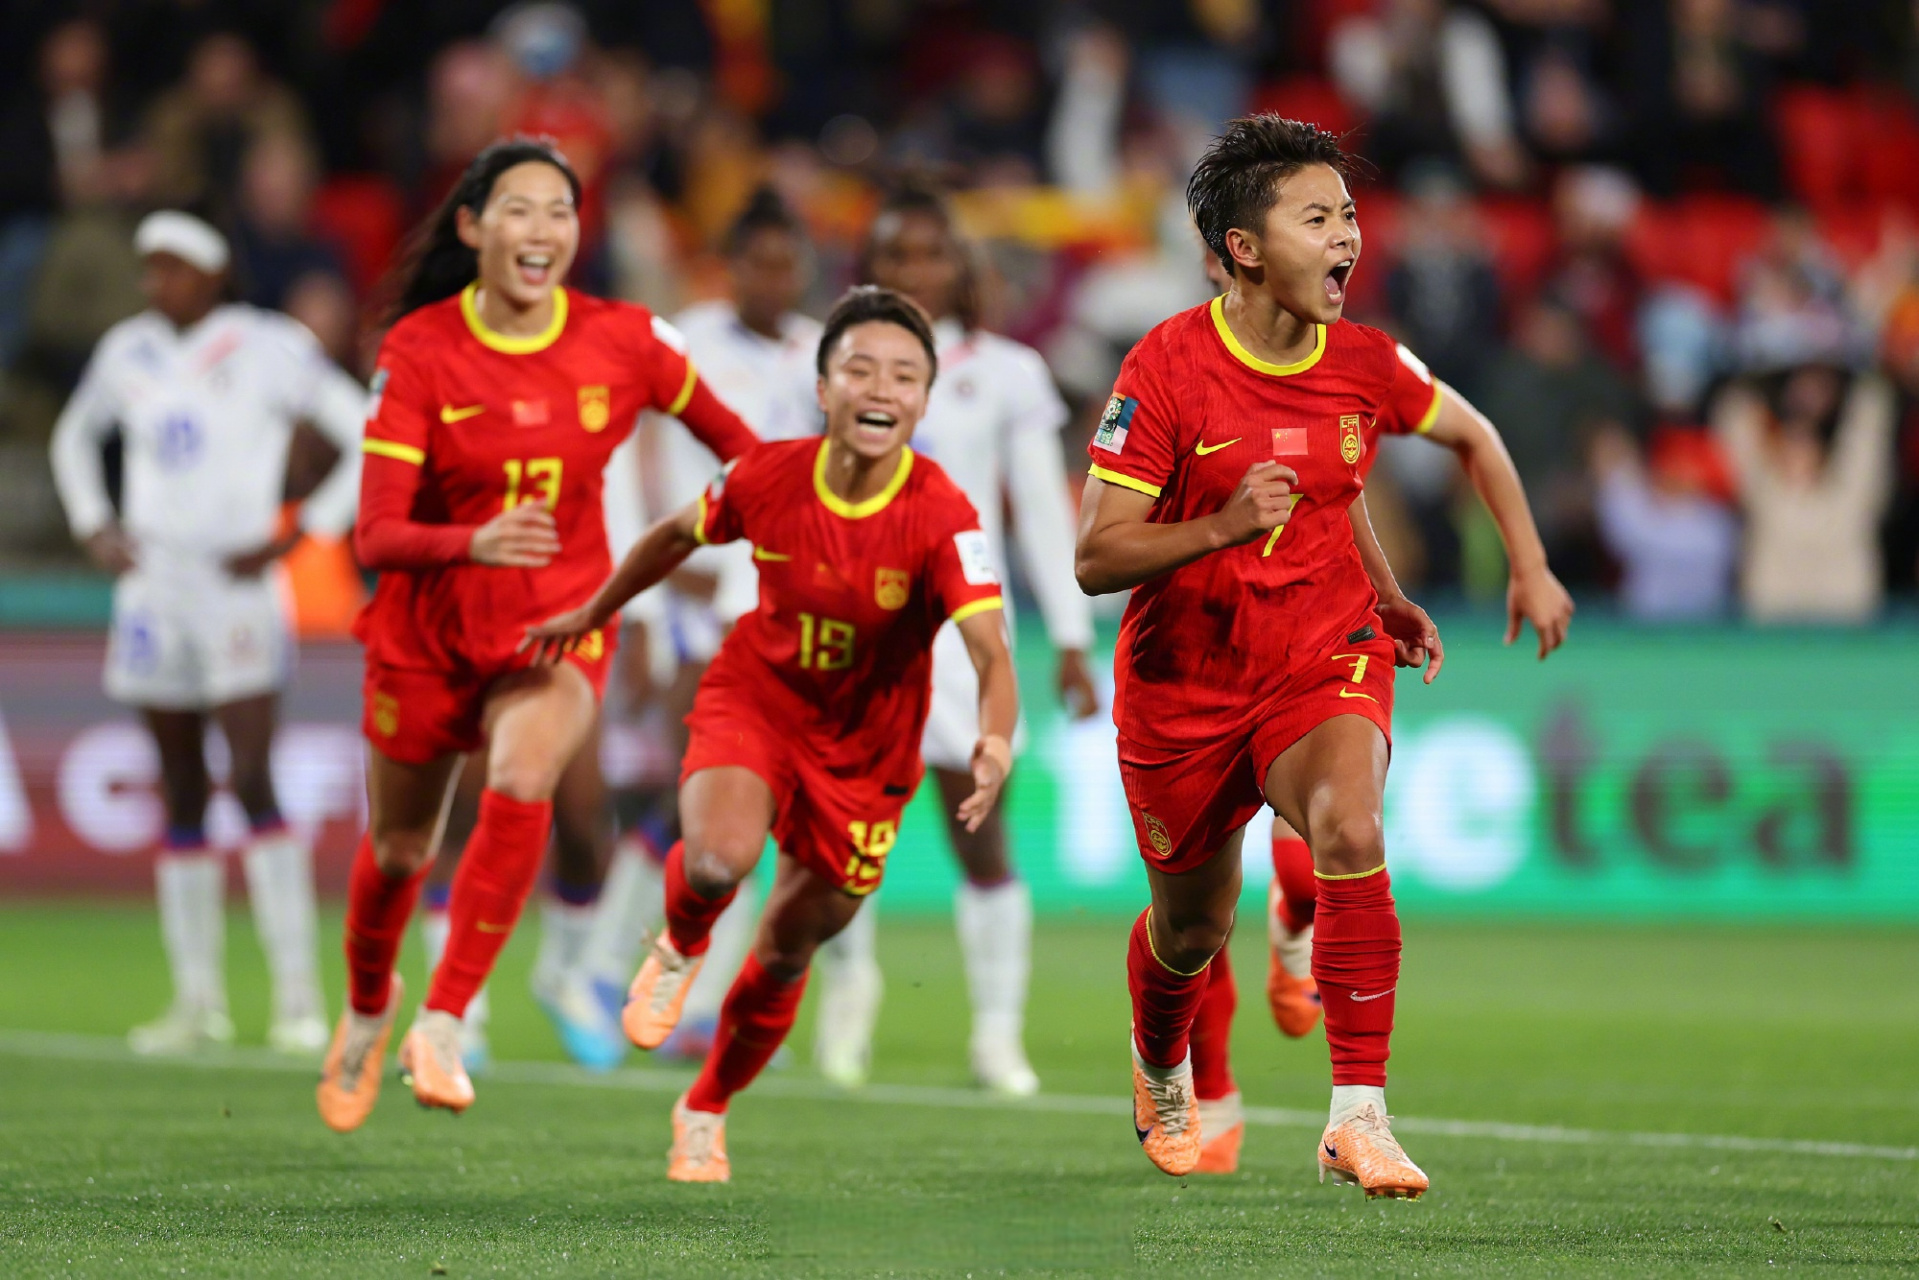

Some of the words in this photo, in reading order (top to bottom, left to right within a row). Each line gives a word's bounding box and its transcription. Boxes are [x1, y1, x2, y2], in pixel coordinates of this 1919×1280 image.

[503, 457, 563, 514] 13
[1262, 493, 1304, 558] 7
[798, 612, 856, 672] 19
[1331, 653, 1369, 684] 7
